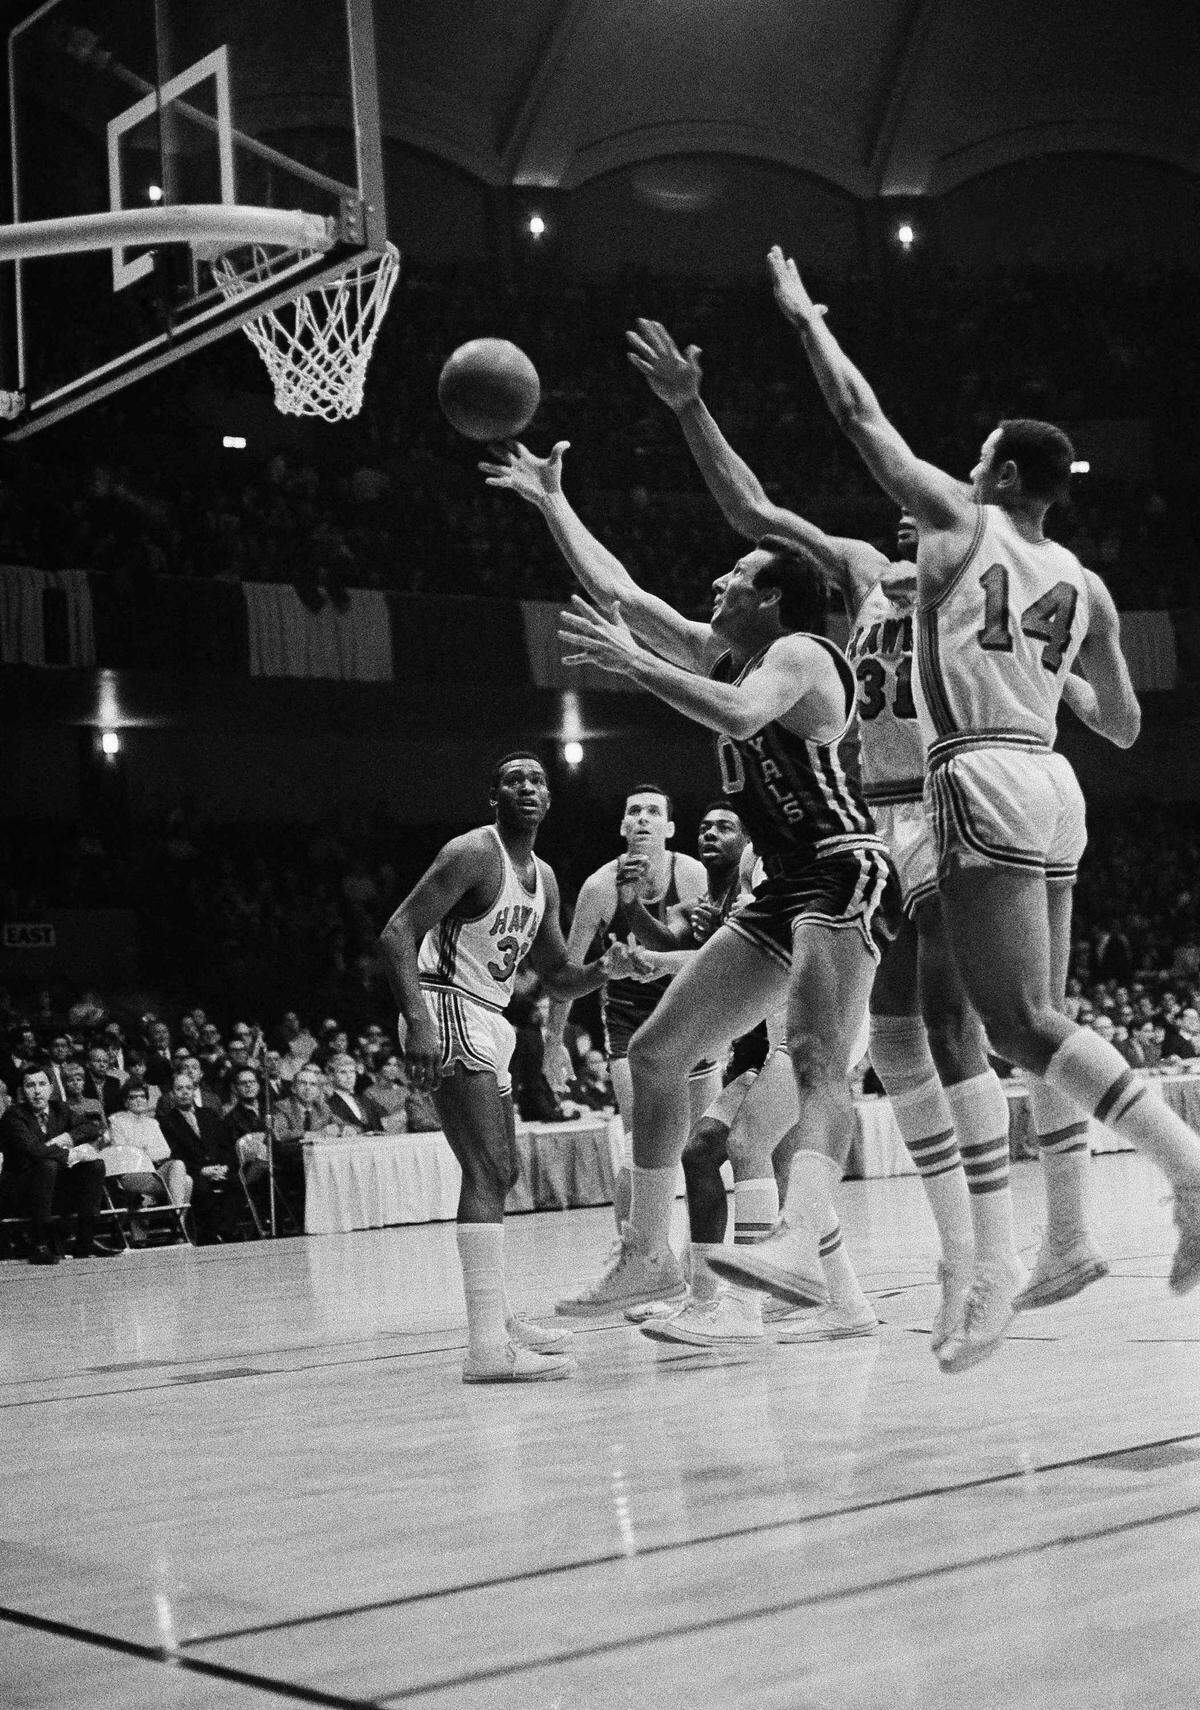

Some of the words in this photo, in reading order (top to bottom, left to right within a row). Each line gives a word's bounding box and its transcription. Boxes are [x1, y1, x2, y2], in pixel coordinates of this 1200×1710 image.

[977, 563, 1079, 675] 14
[856, 657, 918, 720] 31
[747, 735, 805, 824] YALS
[7, 926, 52, 944] EAST
[487, 935, 529, 983] 3
